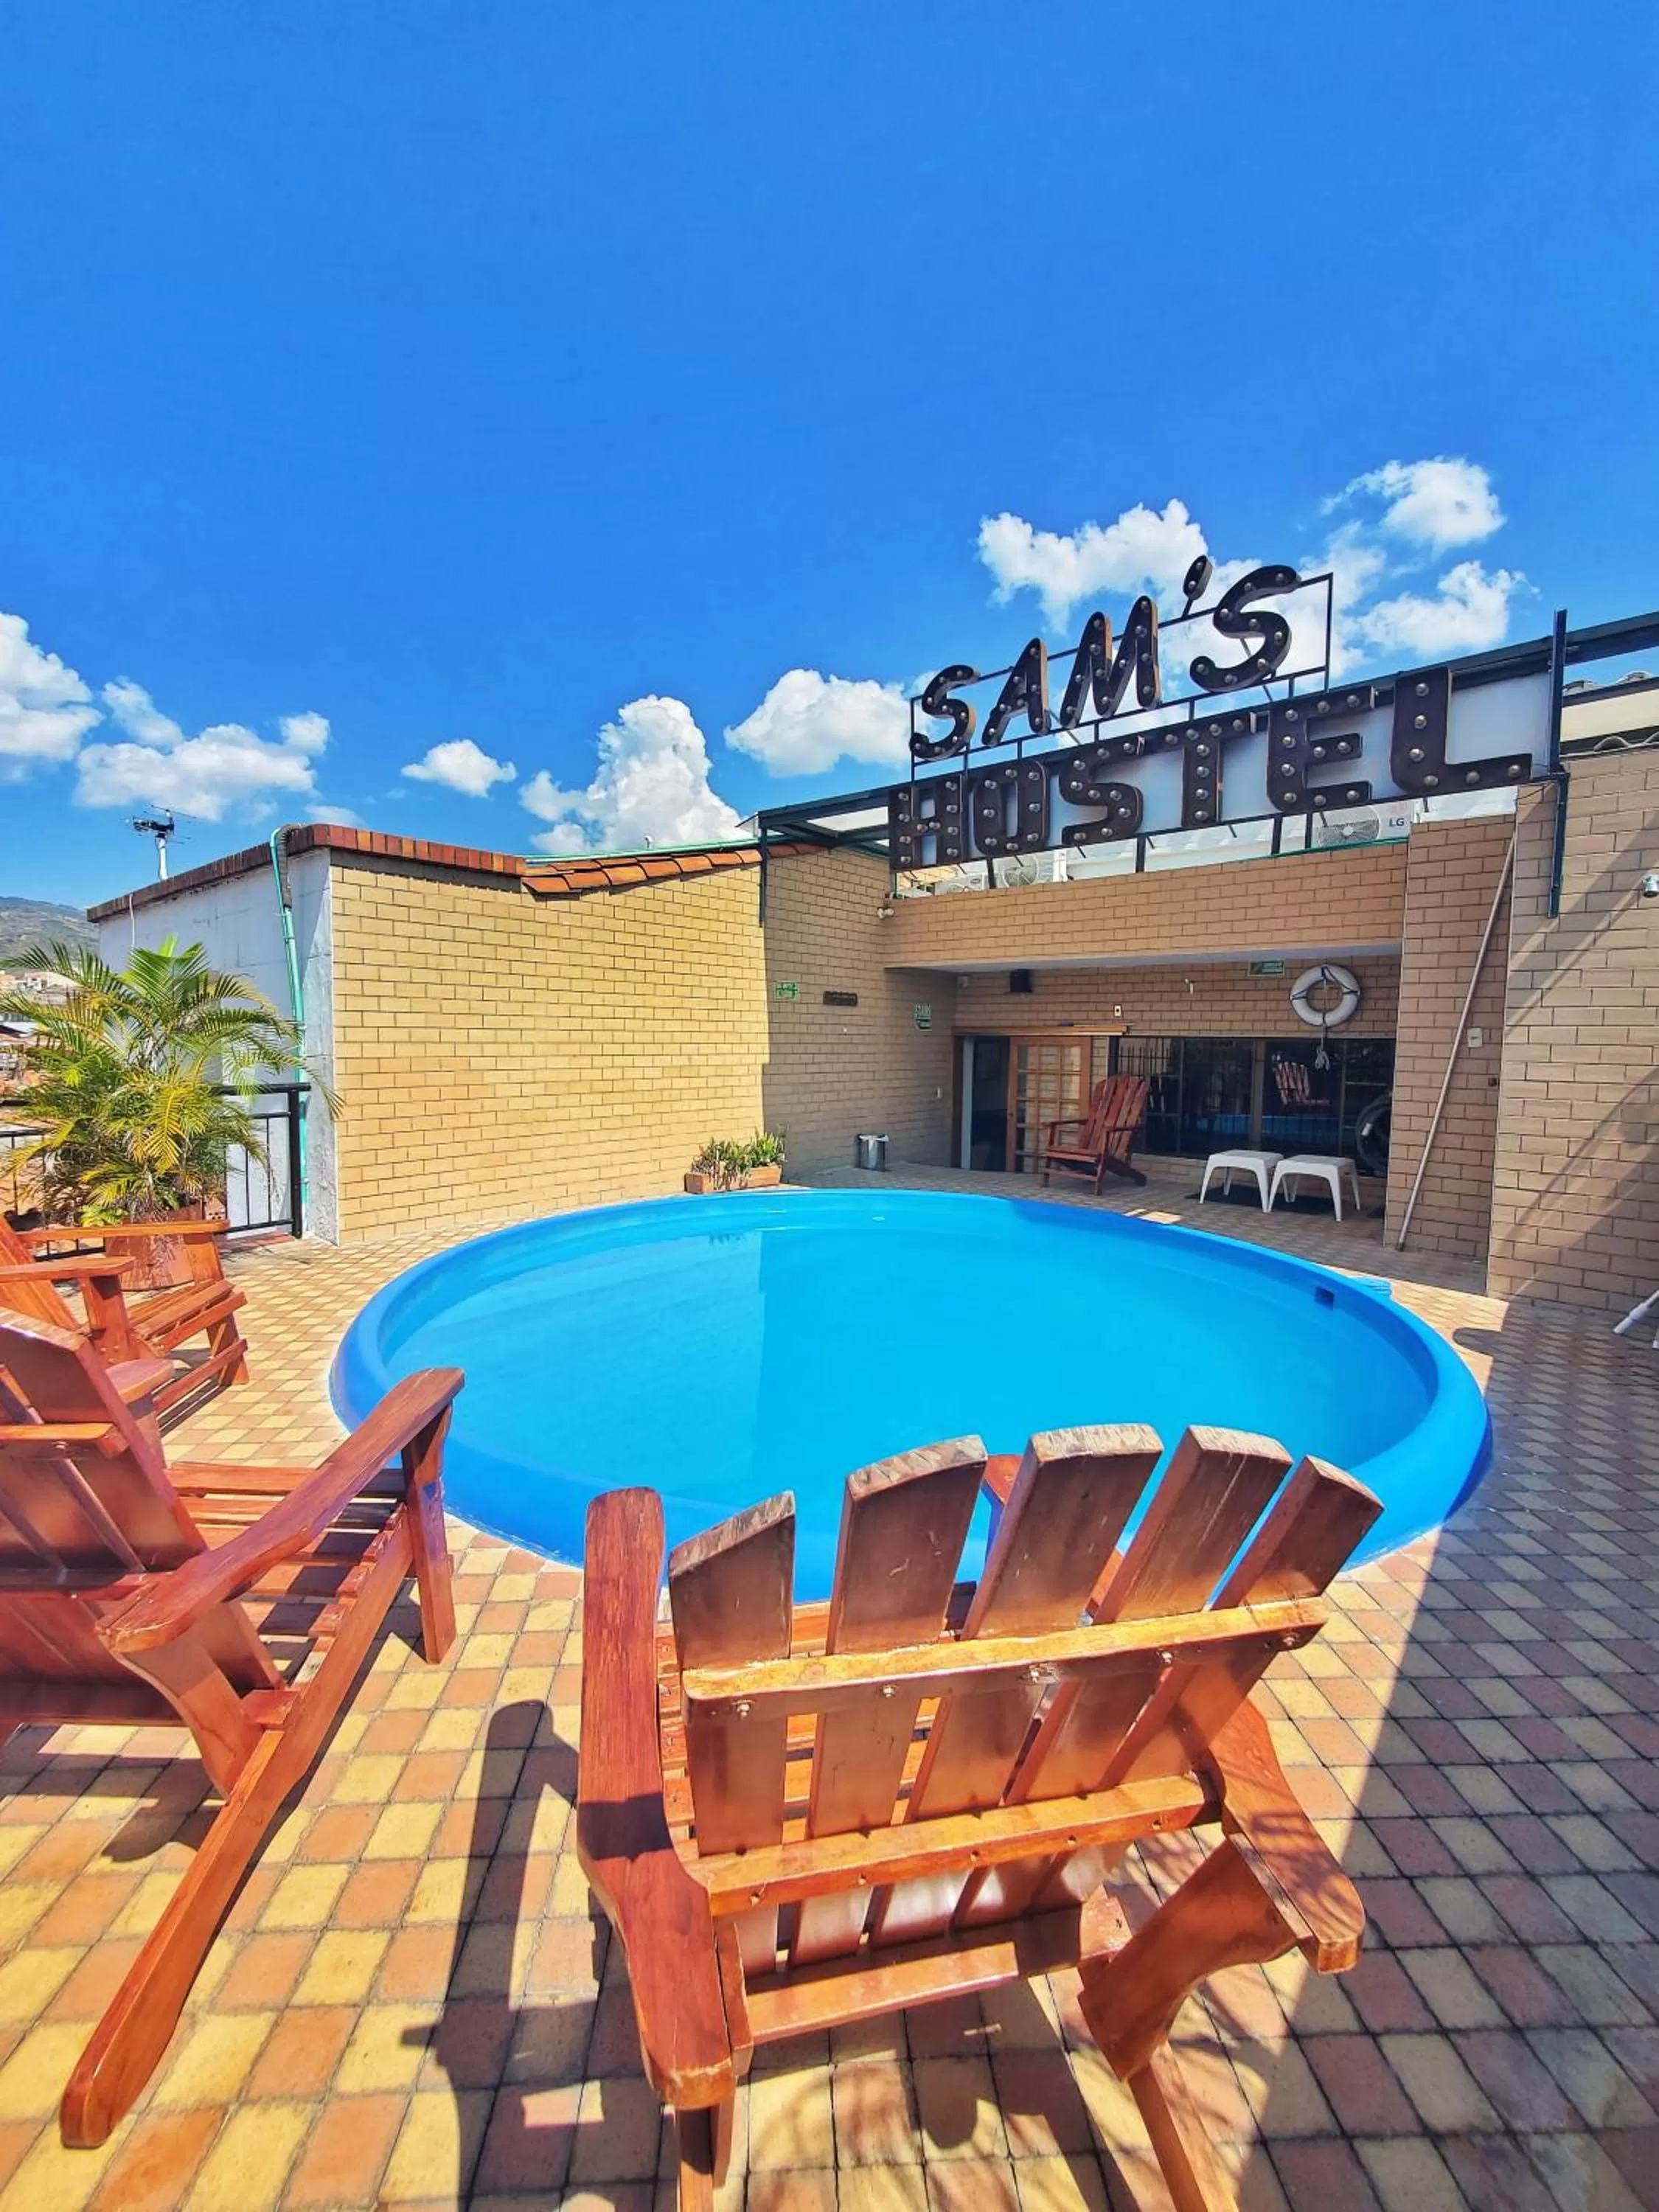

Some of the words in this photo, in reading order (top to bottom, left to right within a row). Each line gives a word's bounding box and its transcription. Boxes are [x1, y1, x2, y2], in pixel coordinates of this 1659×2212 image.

[909, 554, 1302, 761] SAM'S
[888, 668, 1532, 870] HOSTEL
[1389, 818, 1405, 827] LG
